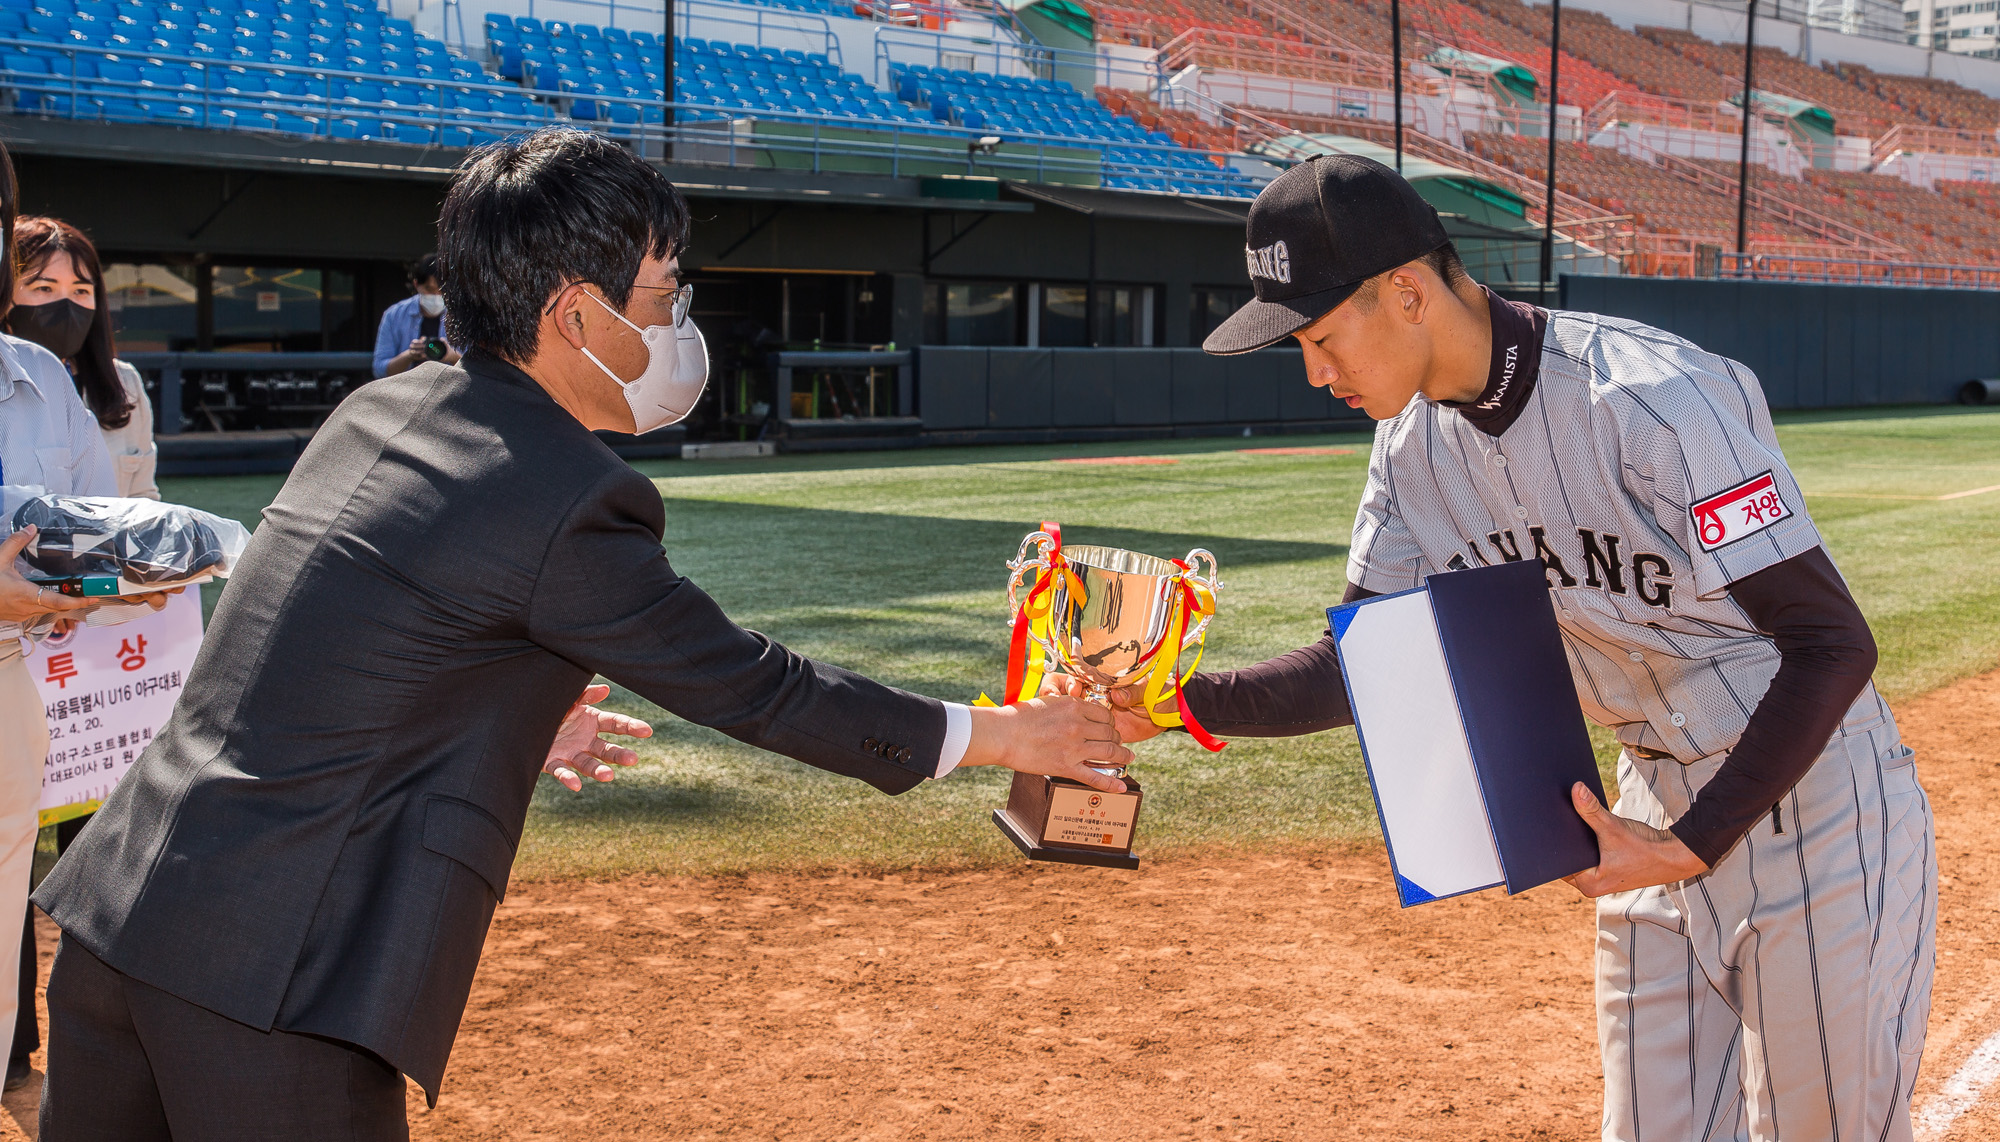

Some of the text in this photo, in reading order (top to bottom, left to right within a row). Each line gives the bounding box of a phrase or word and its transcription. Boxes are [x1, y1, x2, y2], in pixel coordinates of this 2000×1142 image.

[1491, 344, 1518, 401] KAMISTA
[1741, 491, 1782, 525] 자양
[45, 652, 78, 689] 투
[115, 634, 148, 672] 상
[45, 670, 182, 721] 서울특별시 U16 야구대회
[69, 723, 81, 734] 4.
[85, 717, 103, 730] 20.
[50, 761, 97, 783] 대표이사
